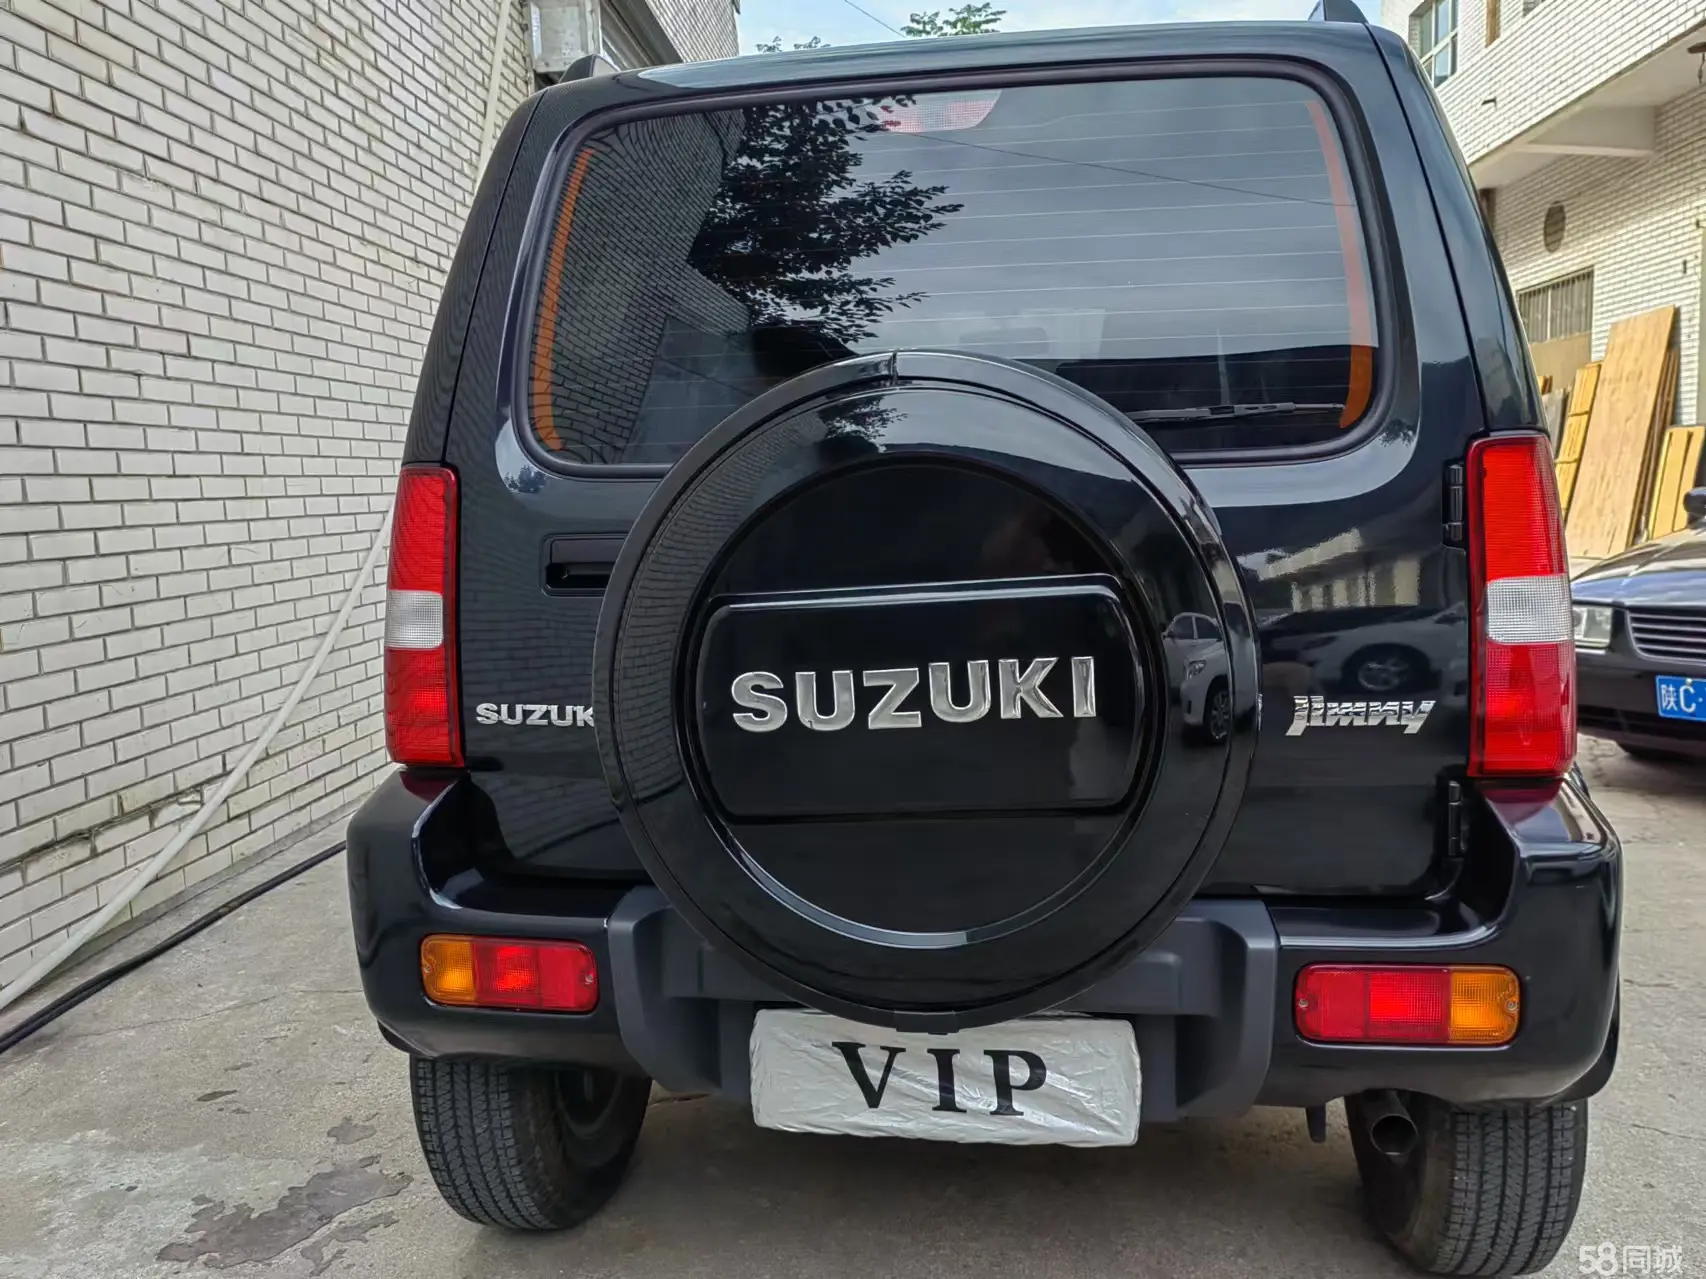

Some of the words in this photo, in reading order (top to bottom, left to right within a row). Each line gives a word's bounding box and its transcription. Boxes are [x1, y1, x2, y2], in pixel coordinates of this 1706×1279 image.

[476, 703, 594, 727] SUZUK
[731, 656, 1097, 733] SUZUKI
[832, 1041, 1047, 1116] VIP
